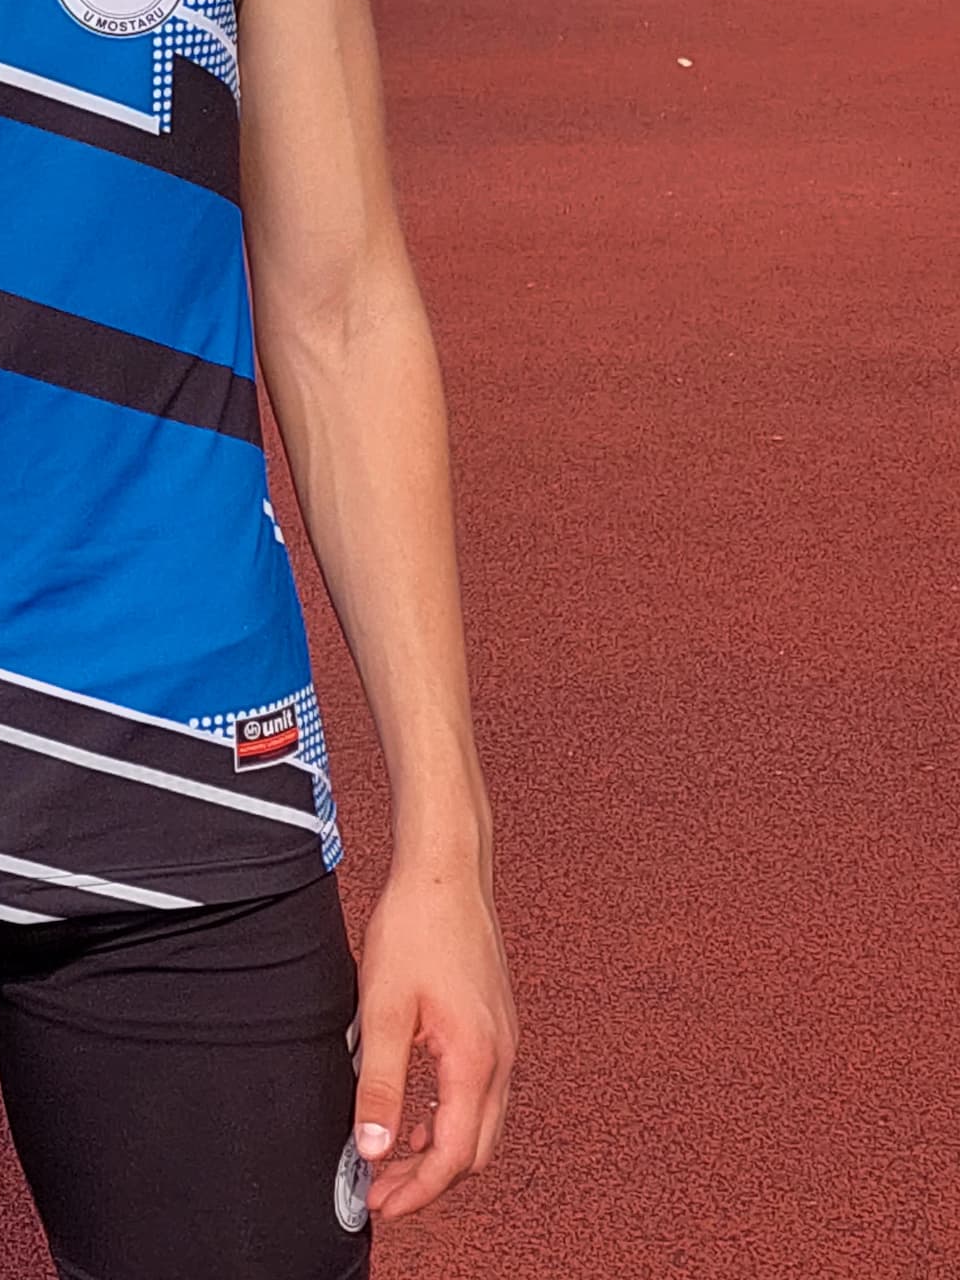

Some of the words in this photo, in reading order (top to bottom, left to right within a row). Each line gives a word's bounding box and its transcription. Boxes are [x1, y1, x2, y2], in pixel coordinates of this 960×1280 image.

[83, 10, 95, 23] U
[95, 7, 165, 32] MOSTARU
[262, 708, 294, 737] unit
